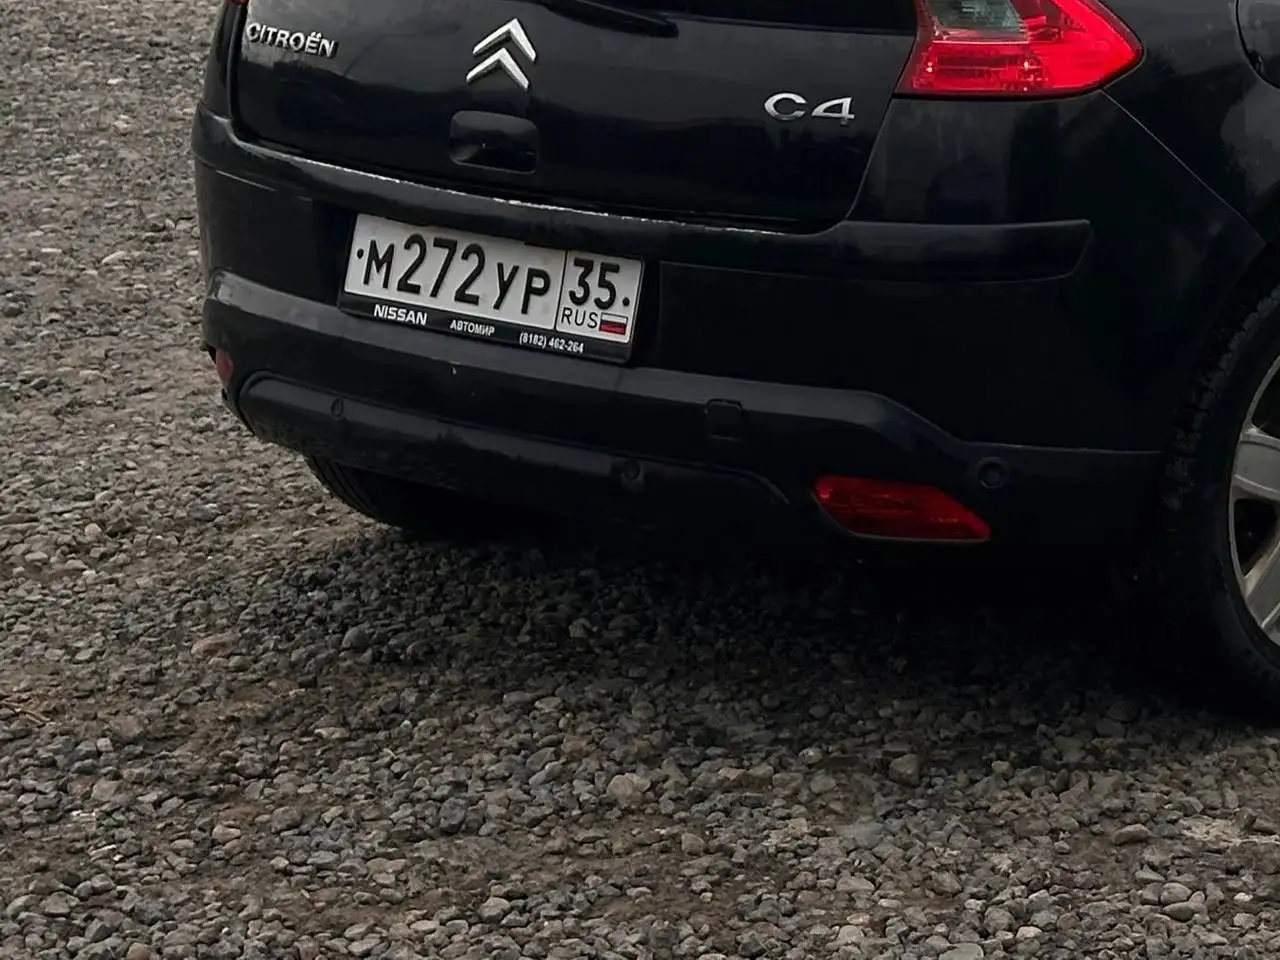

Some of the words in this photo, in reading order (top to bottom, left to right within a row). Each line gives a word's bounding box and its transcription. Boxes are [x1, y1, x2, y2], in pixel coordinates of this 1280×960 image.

[246, 22, 335, 58] CITROËN
[764, 92, 855, 125] C4
[568, 257, 620, 310] 35
[374, 303, 428, 326] NISSAN
[450, 320, 495, 337] АВТОМИР
[560, 307, 599, 329] RUS
